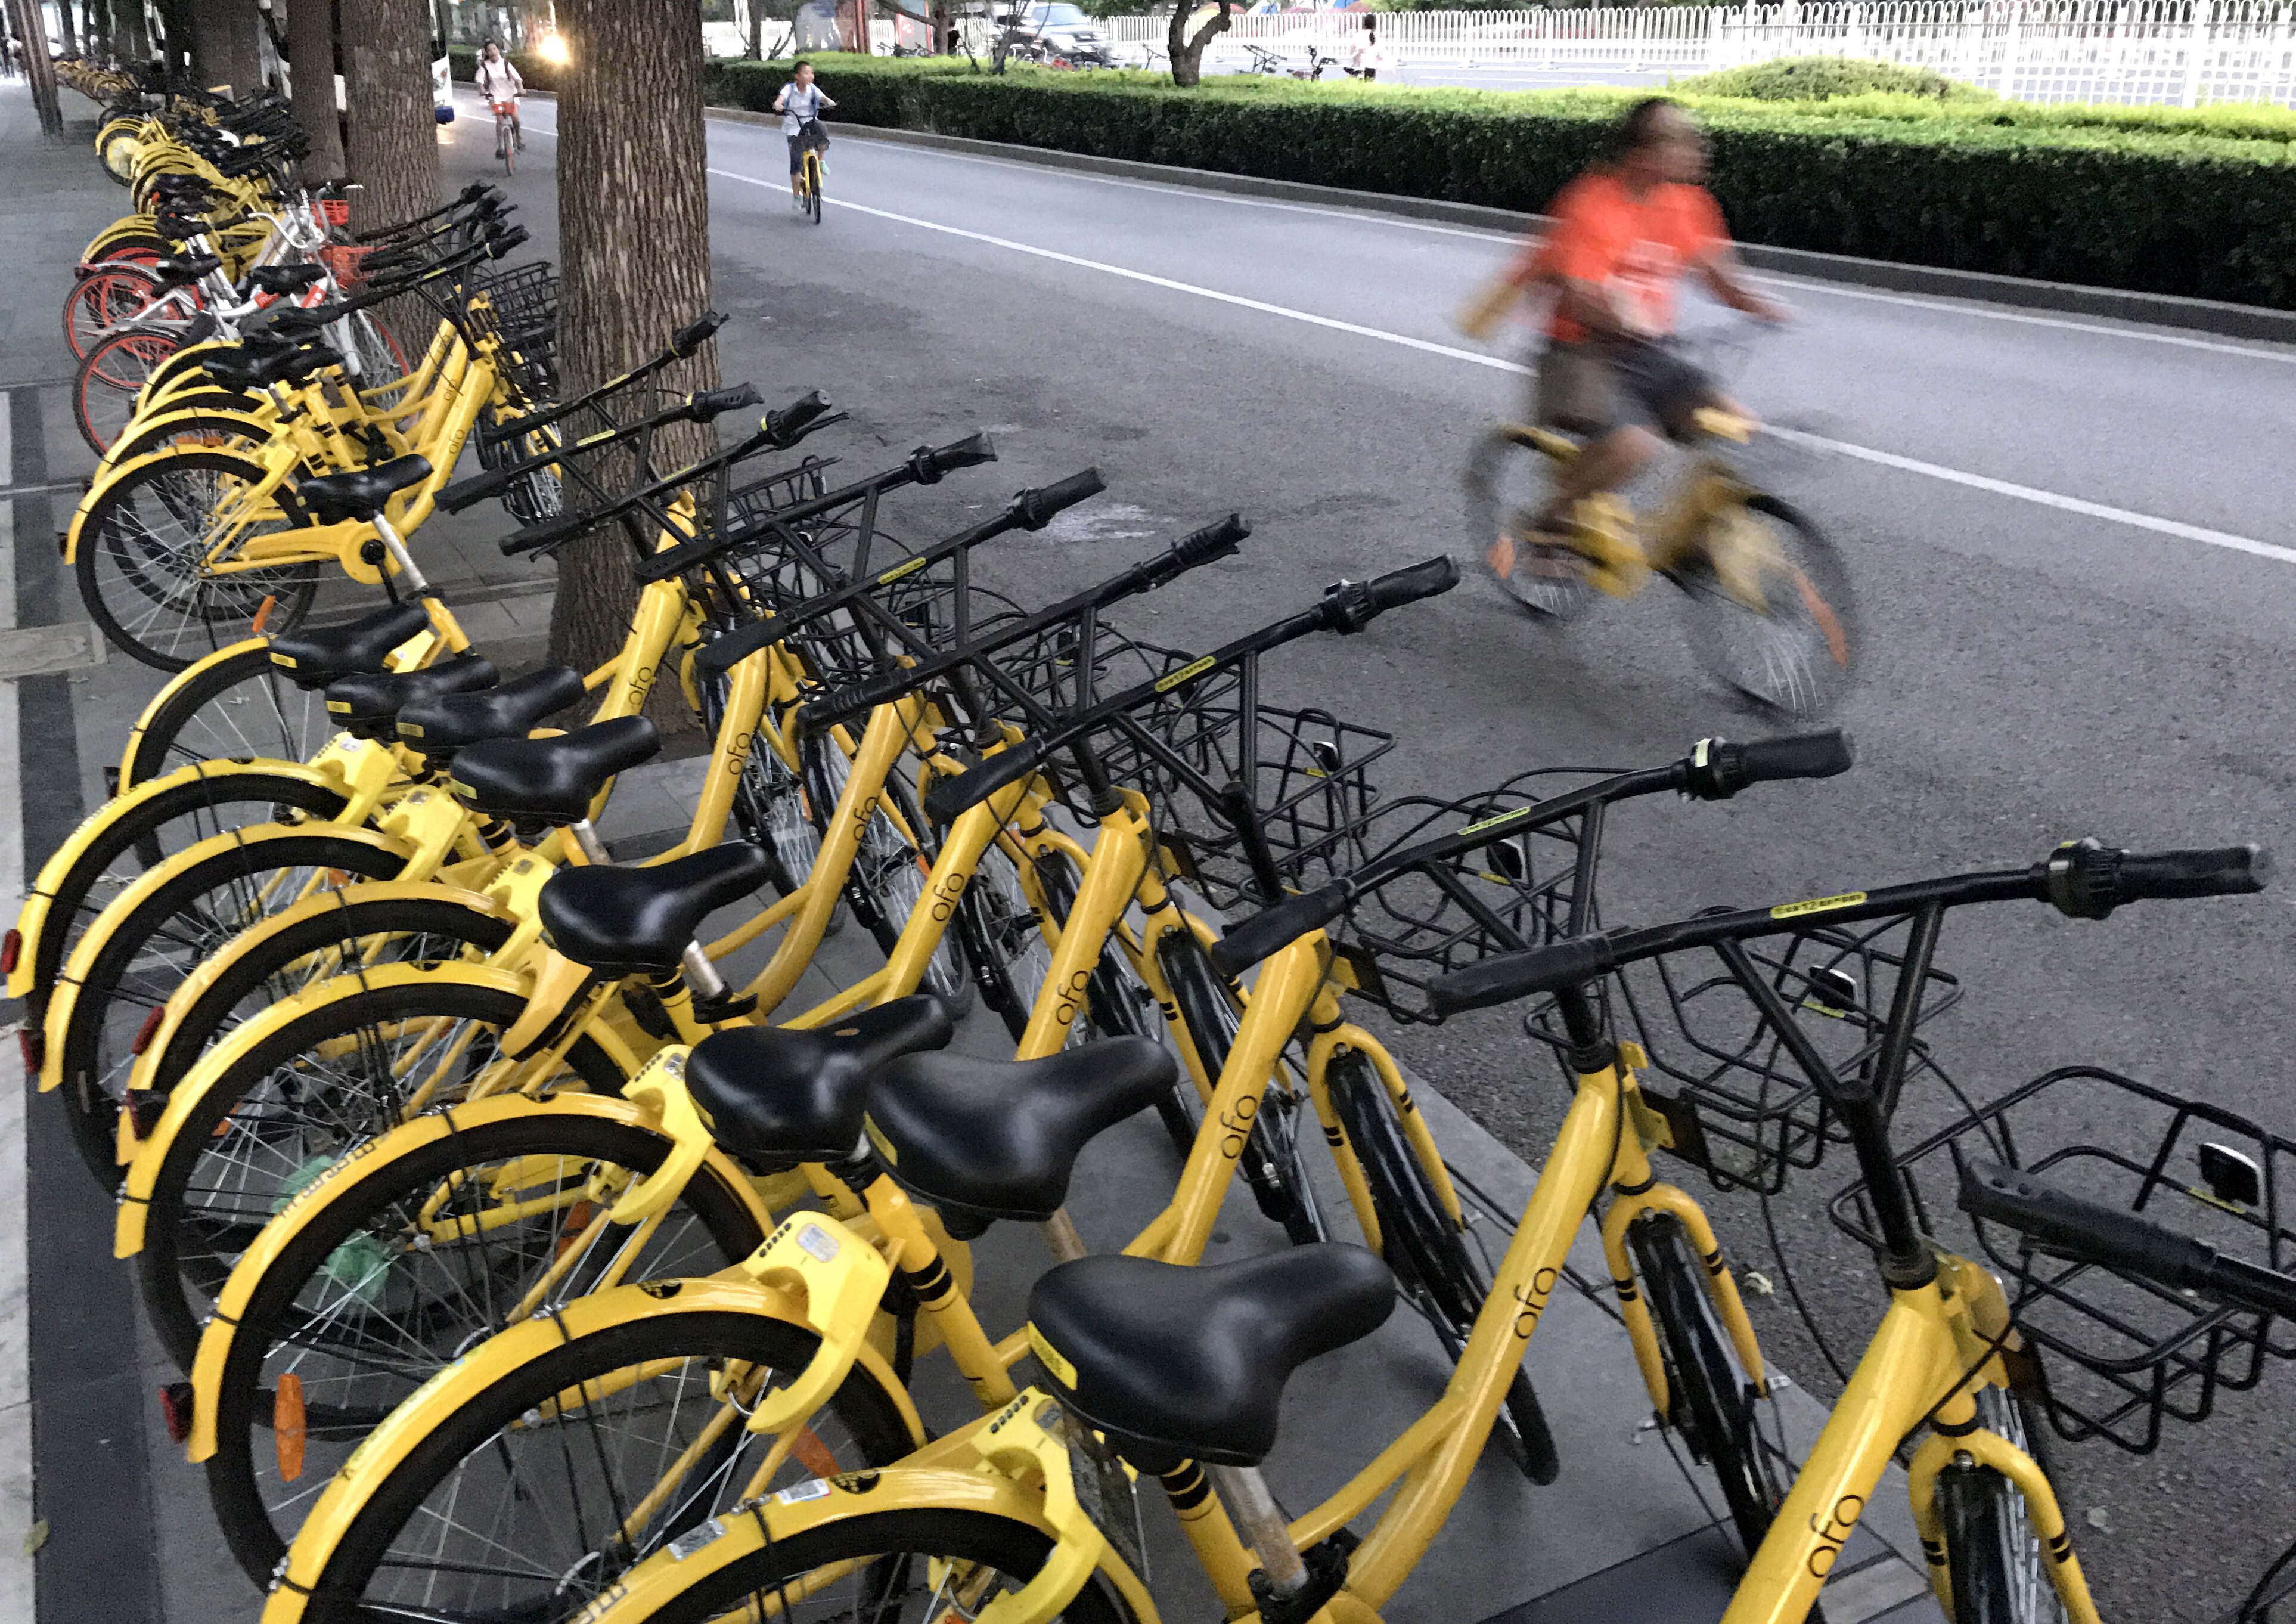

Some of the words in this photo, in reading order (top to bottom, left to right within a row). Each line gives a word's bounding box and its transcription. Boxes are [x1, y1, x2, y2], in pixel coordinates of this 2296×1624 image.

[448, 429, 465, 454] ofo
[629, 666, 652, 705] ofo
[728, 733, 750, 776] ofo
[854, 795, 879, 841] ofo
[932, 873, 964, 922] ofo
[1057, 969, 1090, 1026] ofo
[1220, 1095, 1258, 1160] ofo
[1513, 1266, 1557, 1340] ofo
[1807, 1493, 1865, 1578] ofo
